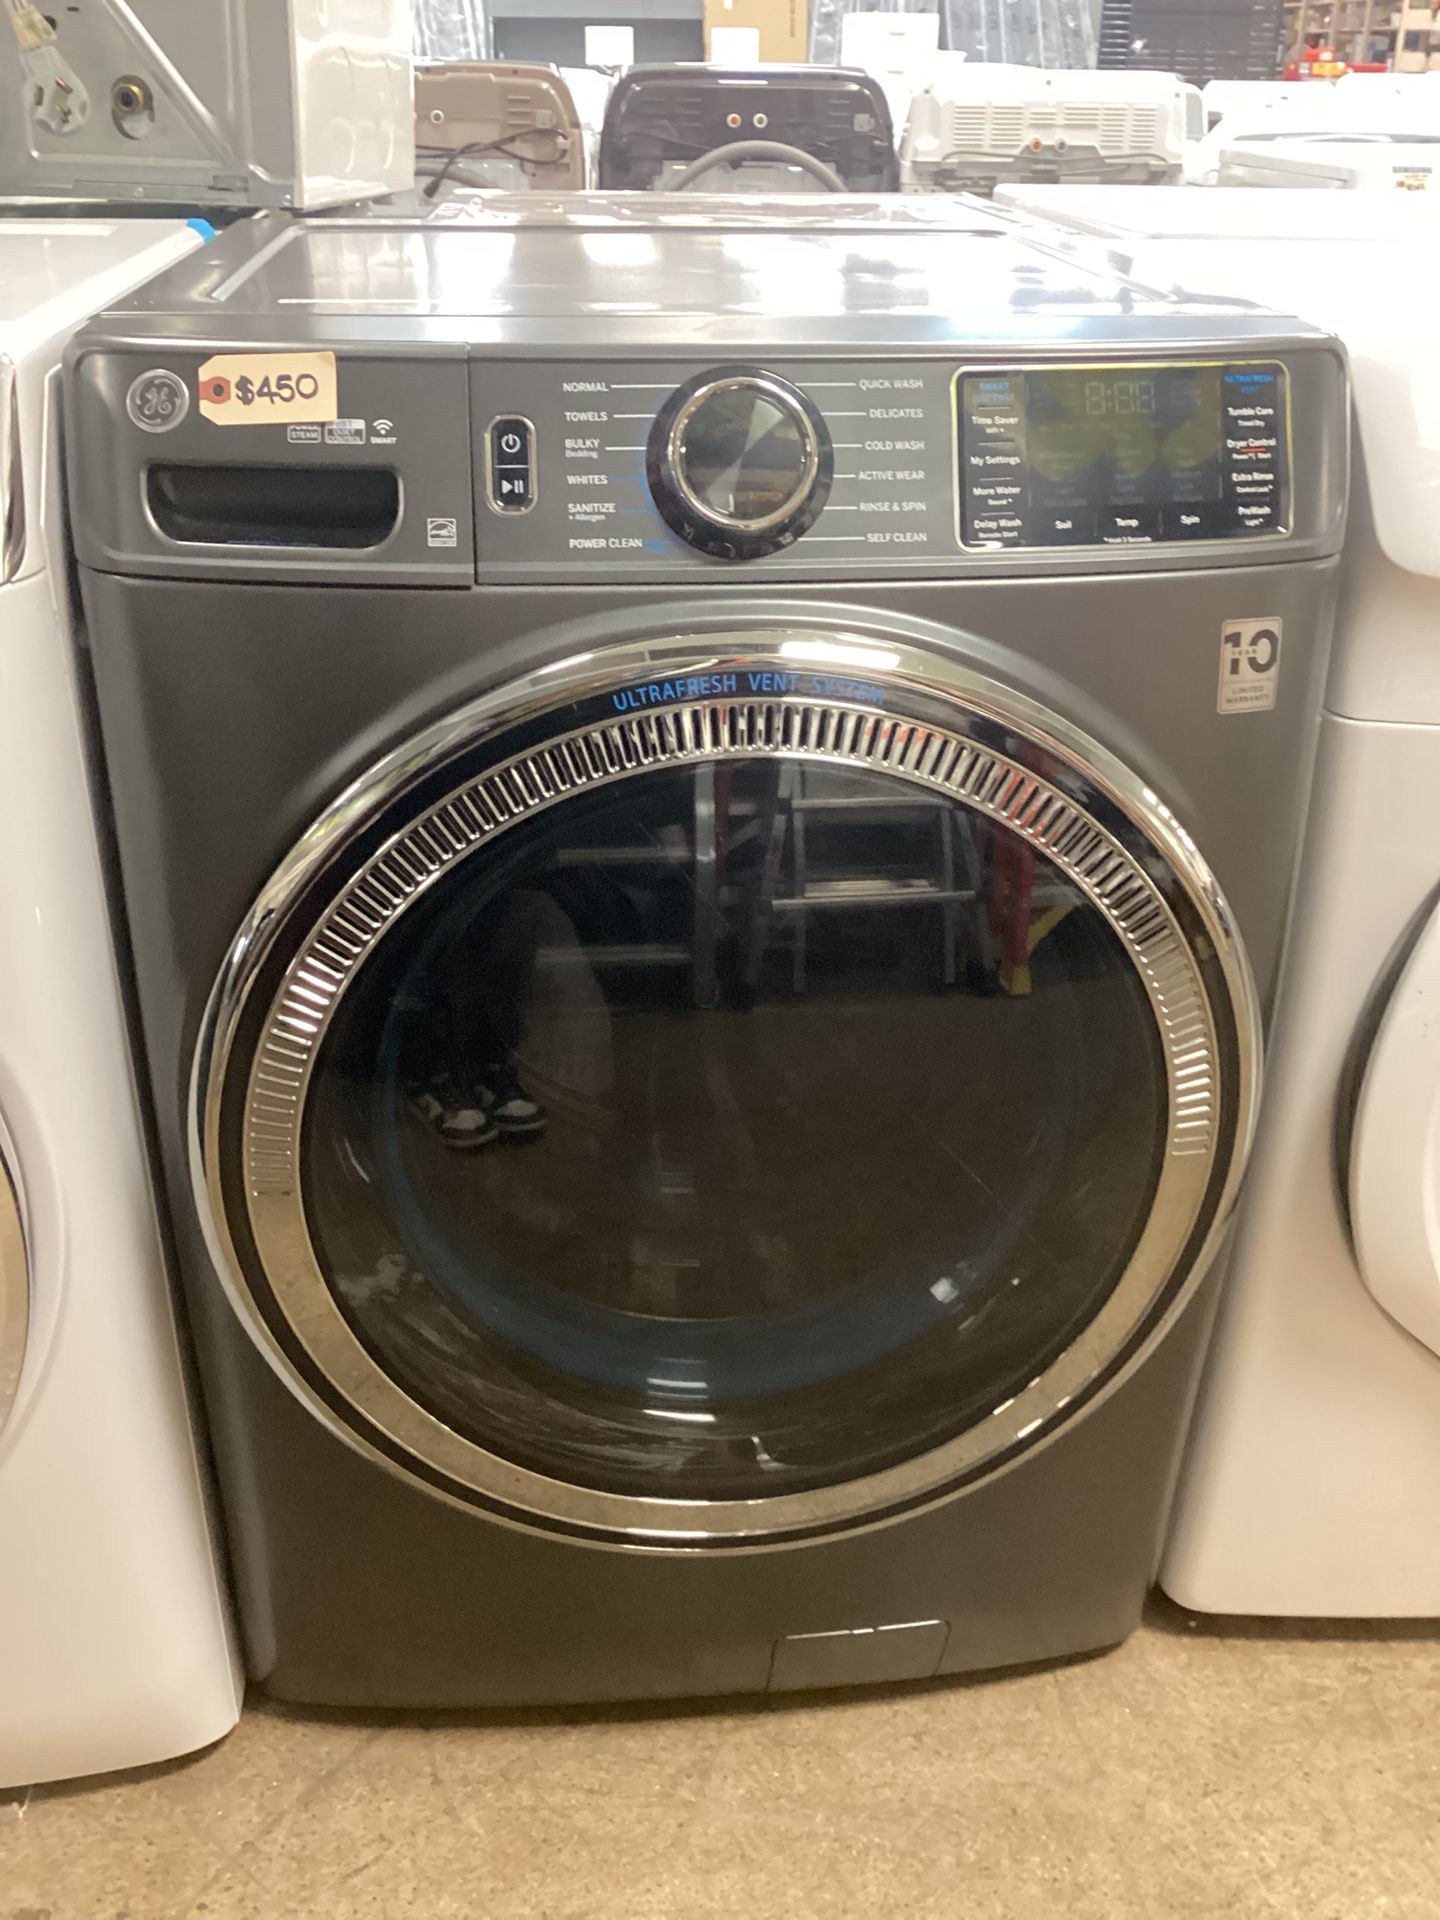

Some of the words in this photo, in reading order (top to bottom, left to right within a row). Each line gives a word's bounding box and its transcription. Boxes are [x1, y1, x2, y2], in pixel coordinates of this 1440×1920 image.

[234, 373, 319, 406] $450
[562, 382, 609, 392] NORMAL
[859, 379, 892, 391] QUICK
[893, 379, 923, 389] WASH
[564, 411, 608, 421] TOWELS
[869, 408, 924, 418] DELICATES
[1227, 406, 1255, 416] Tumble
[1255, 406, 1274, 415] Care
[971, 416, 993, 425] Time
[994, 416, 1019, 425] Saver
[291, 430, 318, 439] STEAM
[565, 438, 600, 449] BULKY
[865, 440, 893, 450] COLD
[894, 440, 925, 450] WASH
[1227, 439, 1248, 449] Dryer
[1248, 438, 1277, 447] Control
[970, 456, 984, 466] My
[985, 455, 1021, 465] Settings
[566, 474, 608, 485] WHITES
[858, 470, 894, 480] ACTIVE
[895, 470, 925, 480] WEAR
[1252, 472, 1274, 480] Rinse
[973, 487, 995, 496] More
[995, 486, 1022, 494] Water
[568, 503, 616, 513] SANITIZE
[859, 502, 891, 512] RINSE
[891, 502, 900, 512] &
[901, 502, 926, 511] SPIN
[974, 520, 998, 529] Delay
[998, 519, 1022, 527] Wash
[1055, 520, 1072, 529] Soil
[1115, 517, 1139, 528] Temp
[1181, 514, 1200, 525] Spin
[866, 533, 892, 542] SELF
[893, 532, 927, 542] CLEAN
[569, 538, 607, 549] POWER
[608, 538, 643, 548] CLEAN
[1224, 629, 1279, 675] 10
[613, 674, 737, 711] ULTRAFRESH
[748, 672, 799, 692] VENT
[811, 676, 886, 704] SYSTEM
[1232, 685, 1264, 695] LIMITED
[1226, 694, 1270, 703] WARRANTY
